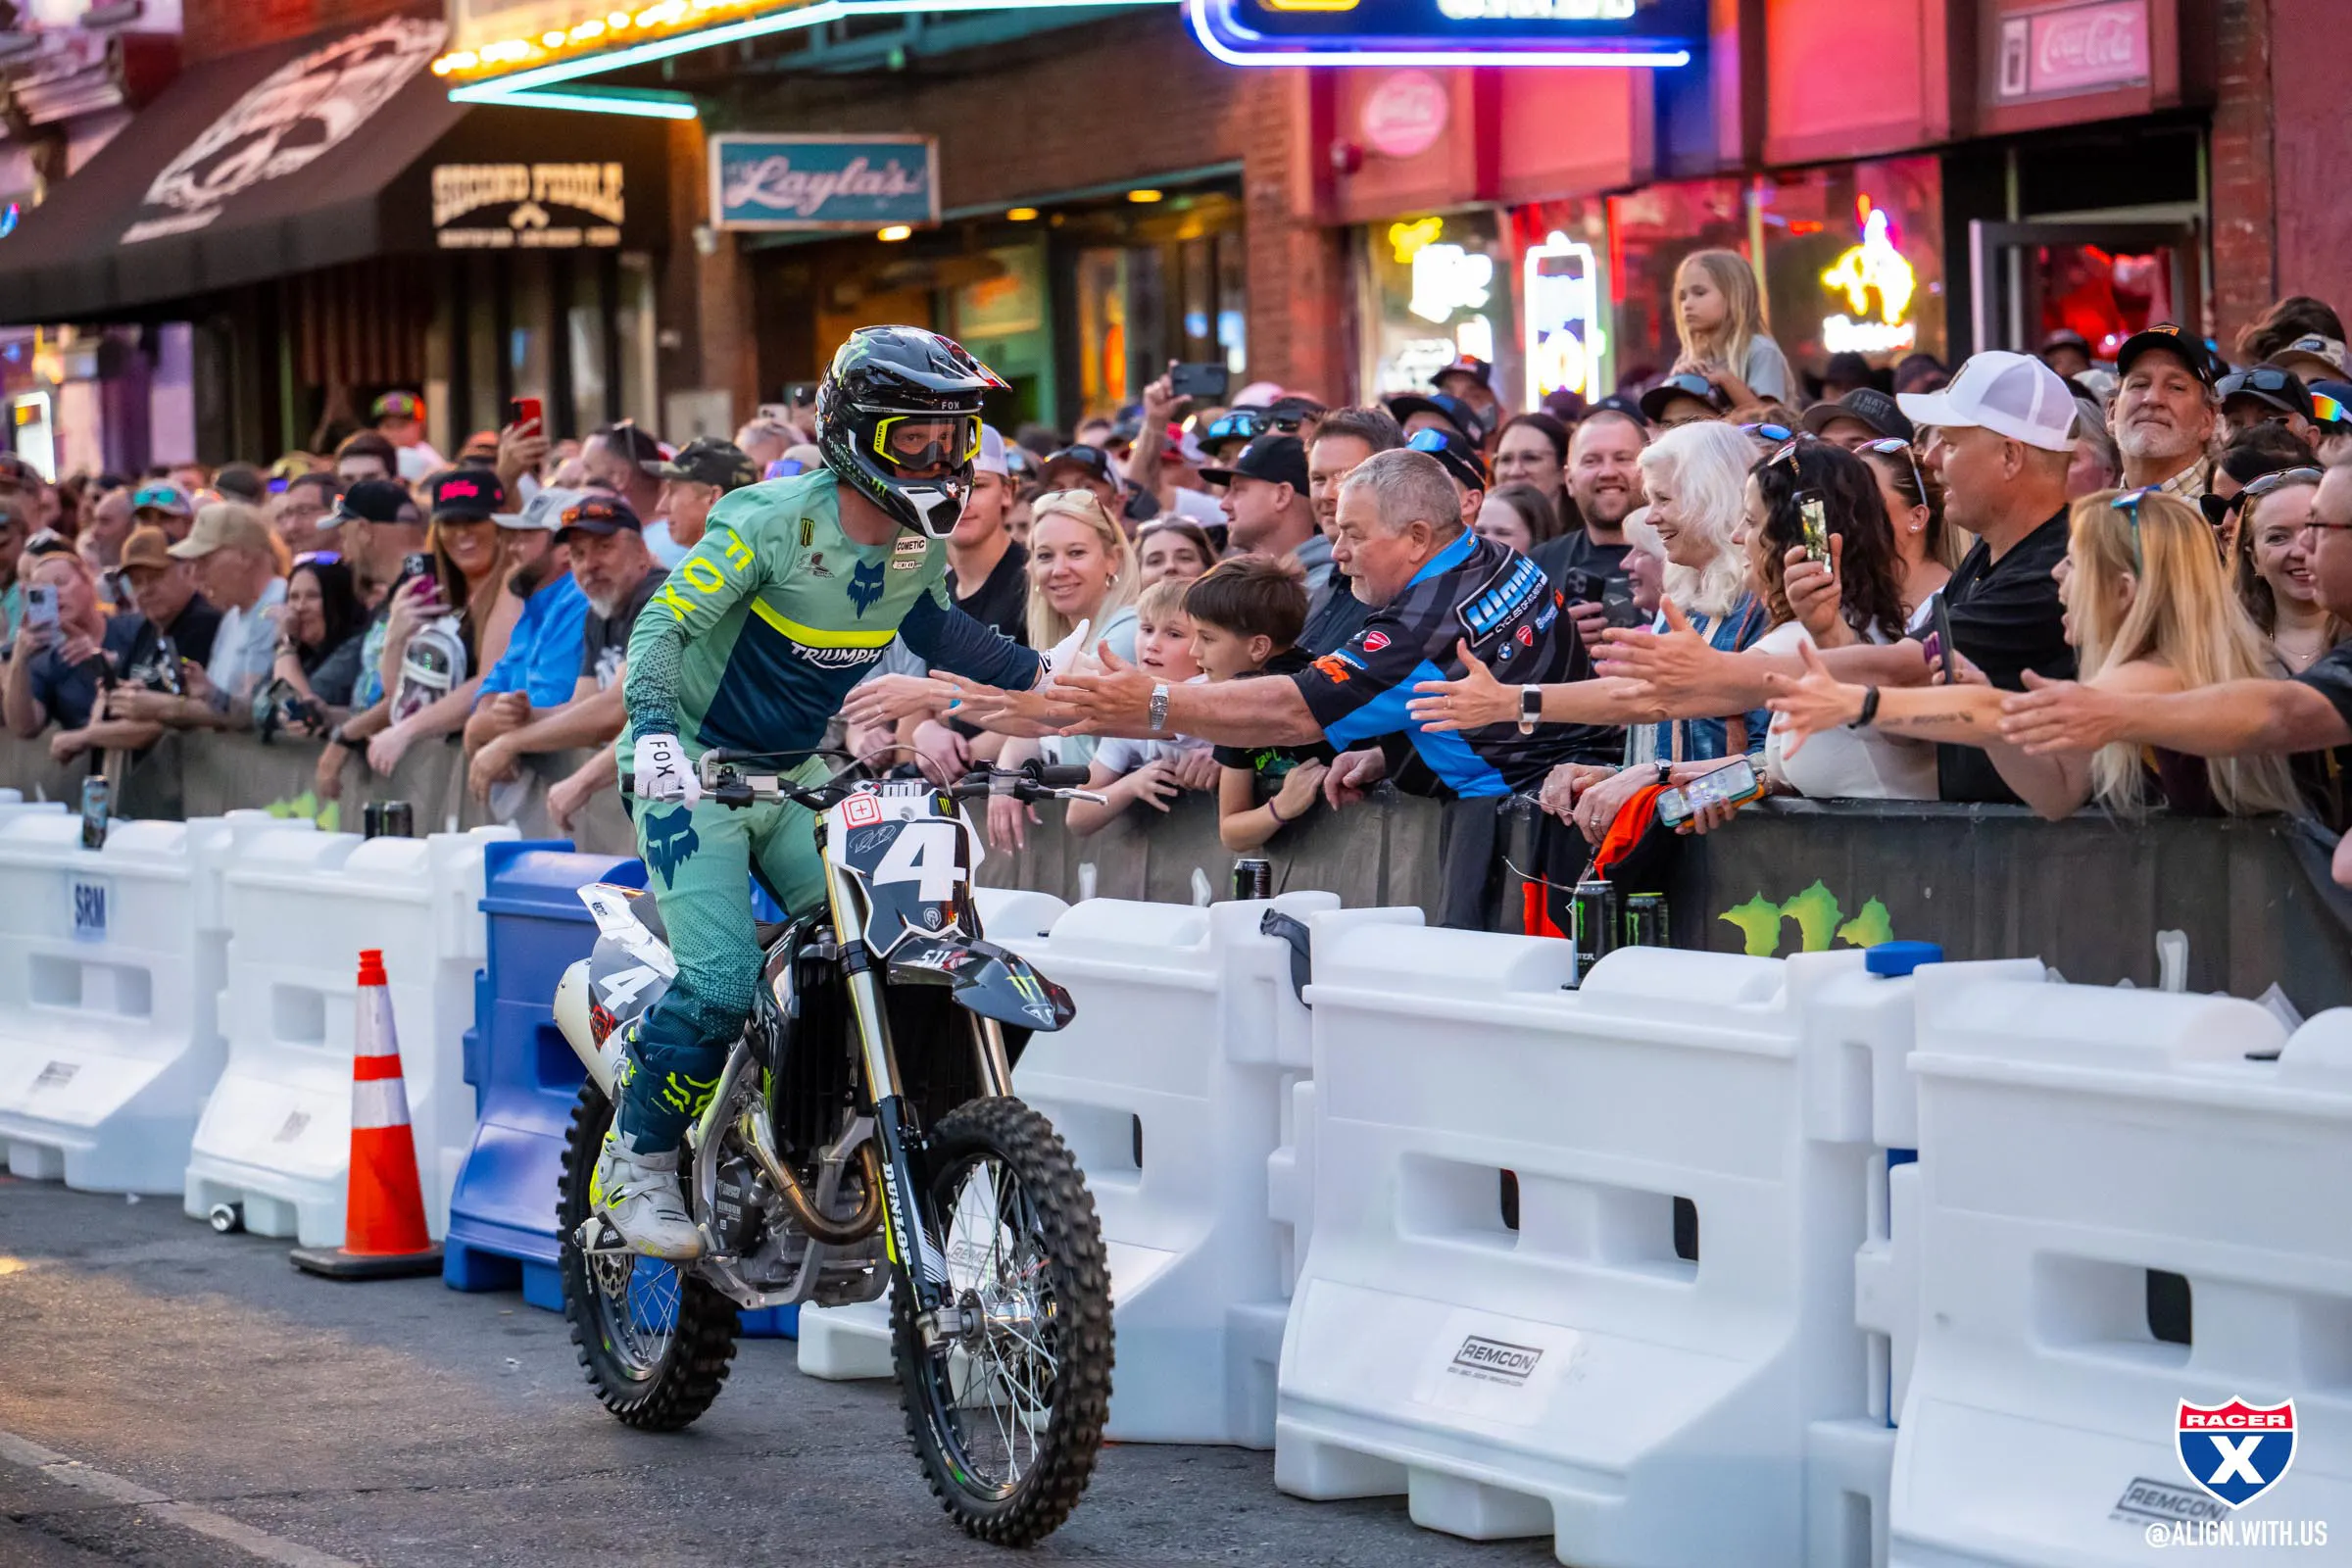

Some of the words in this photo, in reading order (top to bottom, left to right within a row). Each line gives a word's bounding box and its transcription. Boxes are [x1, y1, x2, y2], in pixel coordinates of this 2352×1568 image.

[725, 155, 917, 217] Layla's
[941, 401, 960, 411] FOX
[896, 539, 925, 552] COMETIC
[652, 529, 756, 622] FOX
[1494, 606, 1524, 634] CYCLES
[1519, 600, 1529, 611] OF
[791, 641, 882, 669] TRIUMPH
[649, 741, 675, 779] FOX
[872, 822, 966, 902] 4
[74, 882, 106, 928] SRM
[599, 965, 661, 1011] 4
[882, 1158, 912, 1265] DUNLOP
[1461, 1345, 1535, 1370] REMCON
[2129, 1487, 2225, 1521] REMCON
